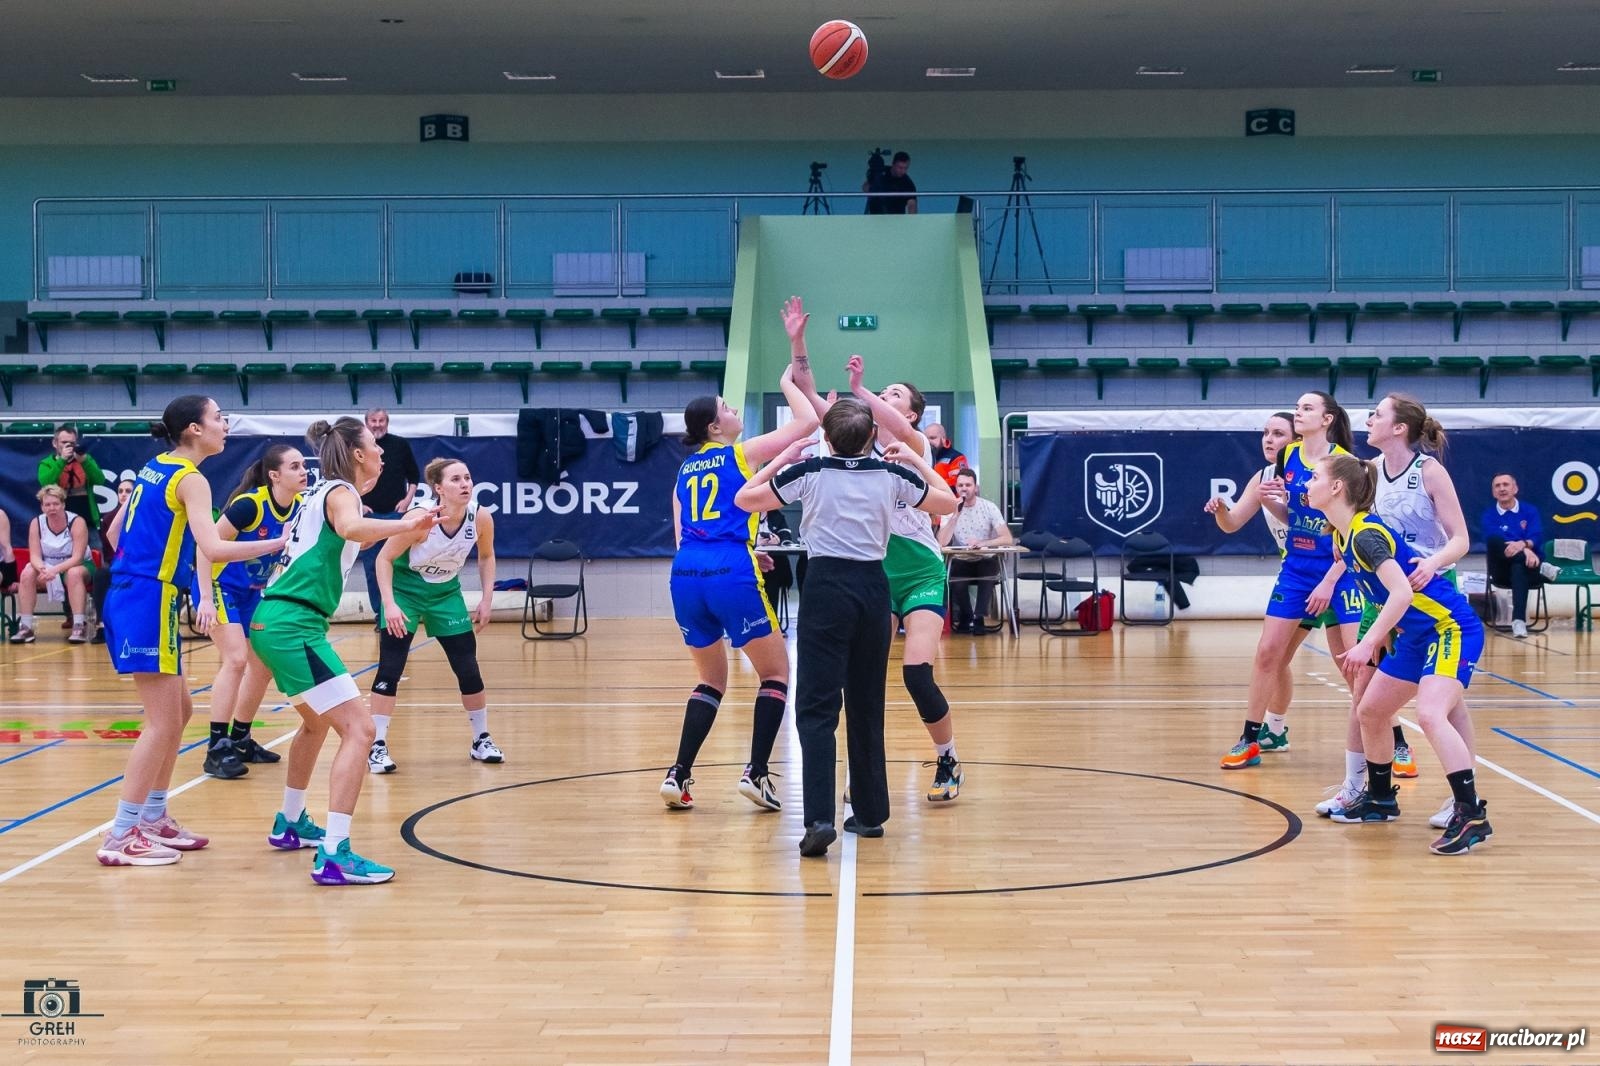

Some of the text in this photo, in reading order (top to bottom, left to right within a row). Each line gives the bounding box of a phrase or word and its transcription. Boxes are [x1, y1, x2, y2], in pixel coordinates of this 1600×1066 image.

[424, 123, 463, 138] B B
[1250, 118, 1292, 132] C C
[1408, 473, 1420, 489] 9
[407, 470, 640, 514] RCIBÓRZ
[687, 473, 720, 522] 12
[1341, 589, 1360, 611] 14
